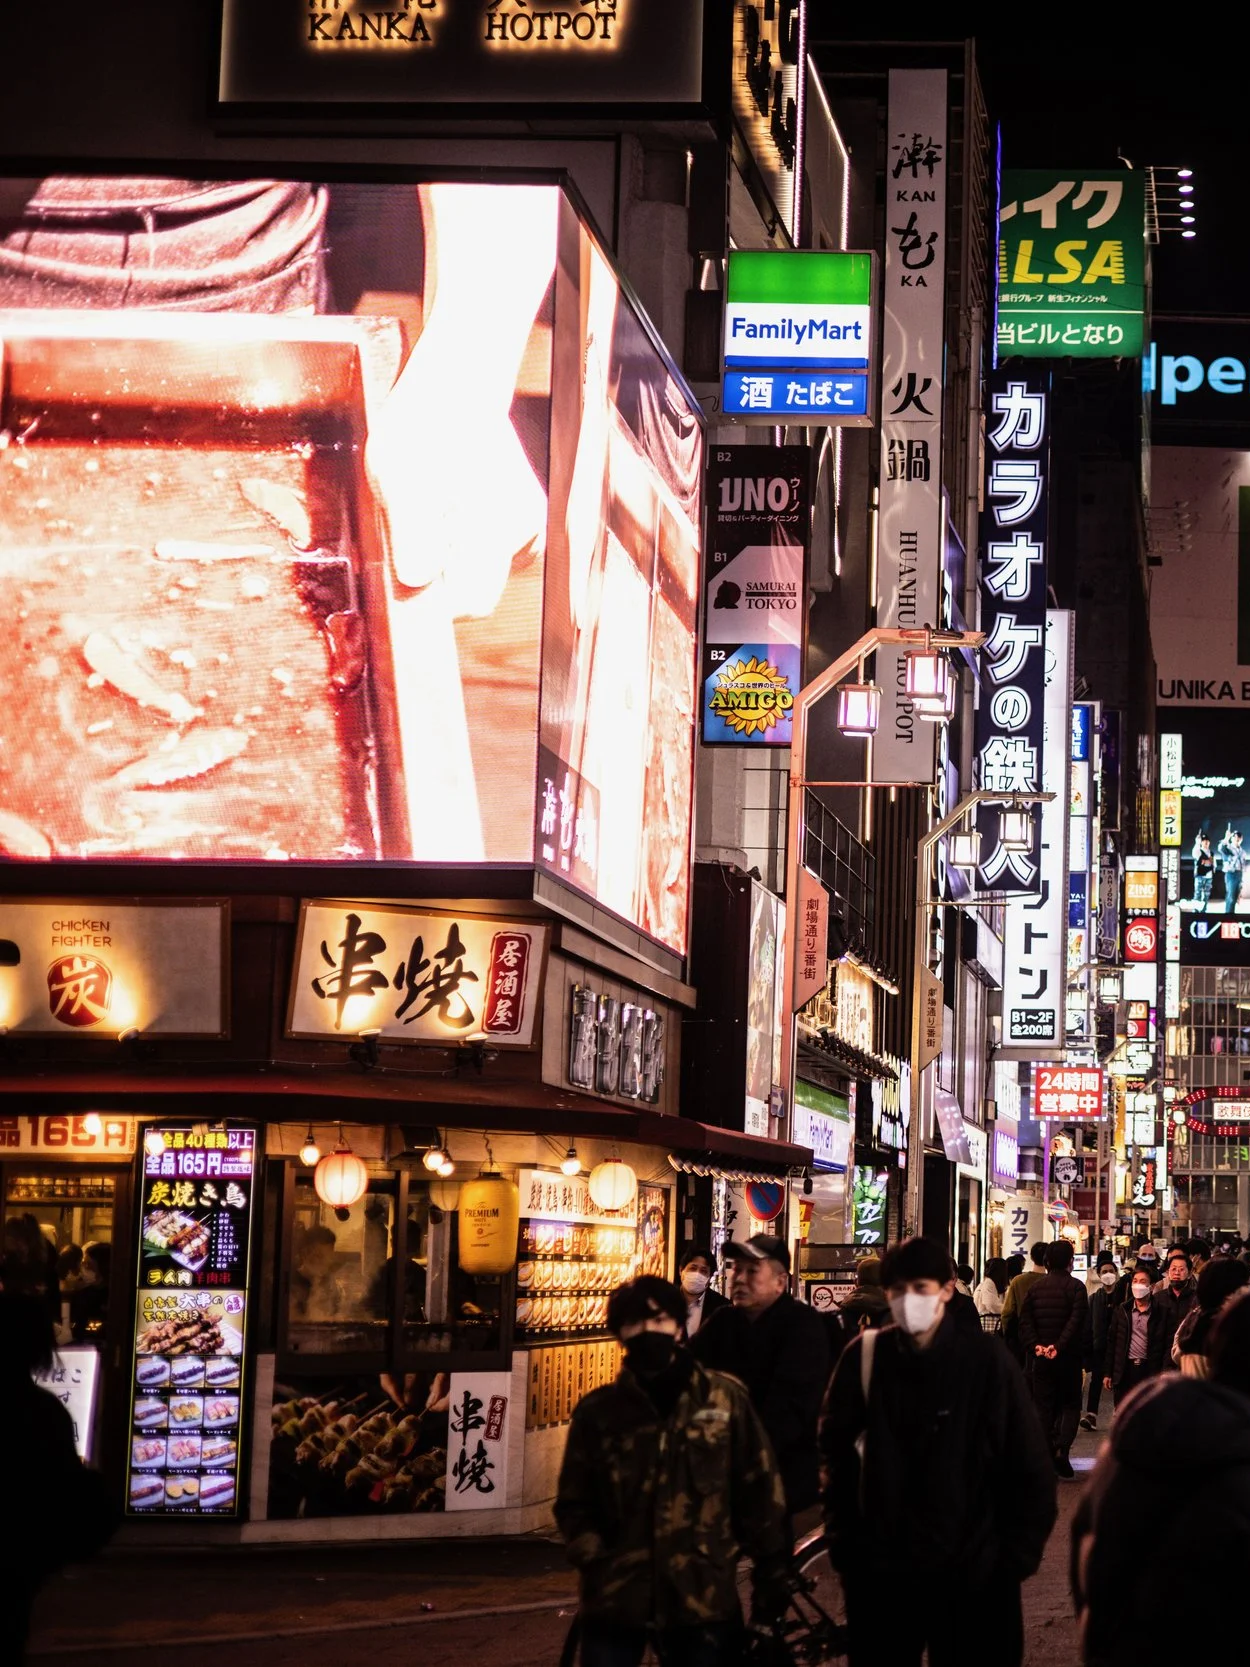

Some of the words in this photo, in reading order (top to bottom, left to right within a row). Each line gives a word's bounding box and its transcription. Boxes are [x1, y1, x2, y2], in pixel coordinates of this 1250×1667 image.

[308, 12, 431, 41] KANKA
[485, 11, 616, 40] HOTPOT
[897, 191, 936, 202] KAN
[999, 240, 1125, 284] LSA
[901, 276, 927, 287] KA
[732, 318, 862, 345] FamilyMart
[997, 322, 1124, 345] 当ビルとなり
[739, 377, 773, 409] 酒
[786, 381, 854, 406] たばこ
[717, 452, 732, 462] B2
[790, 477, 801, 512] ウーノ
[714, 552, 727, 562] B1
[745, 582, 796, 591] SAMURAI
[898, 530, 918, 632] HUANHU
[745, 598, 797, 610] TOKYO
[979, 384, 1046, 886] カラオケの鉄人
[711, 651, 726, 660] B2
[709, 691, 794, 710] AMIGO
[1159, 680, 1235, 701] UNIKA
[52, 919, 110, 933] CHICKEN
[52, 934, 112, 948] FIGHTER
[804, 898, 819, 980] 劇場通り一番街
[311, 913, 479, 1031] 串焼
[51, 956, 110, 1020] 炭
[487, 938, 520, 1030] 居酒屋
[926, 988, 937, 1048] 劇場通り一番街
[1011, 1024, 1053, 1036] 全200席
[1040, 1072, 1100, 1091] 24時間
[1040, 1093, 1099, 1113] 営業中
[465, 1208, 499, 1218] PREMIUM
[451, 1390, 496, 1494] 串焼
